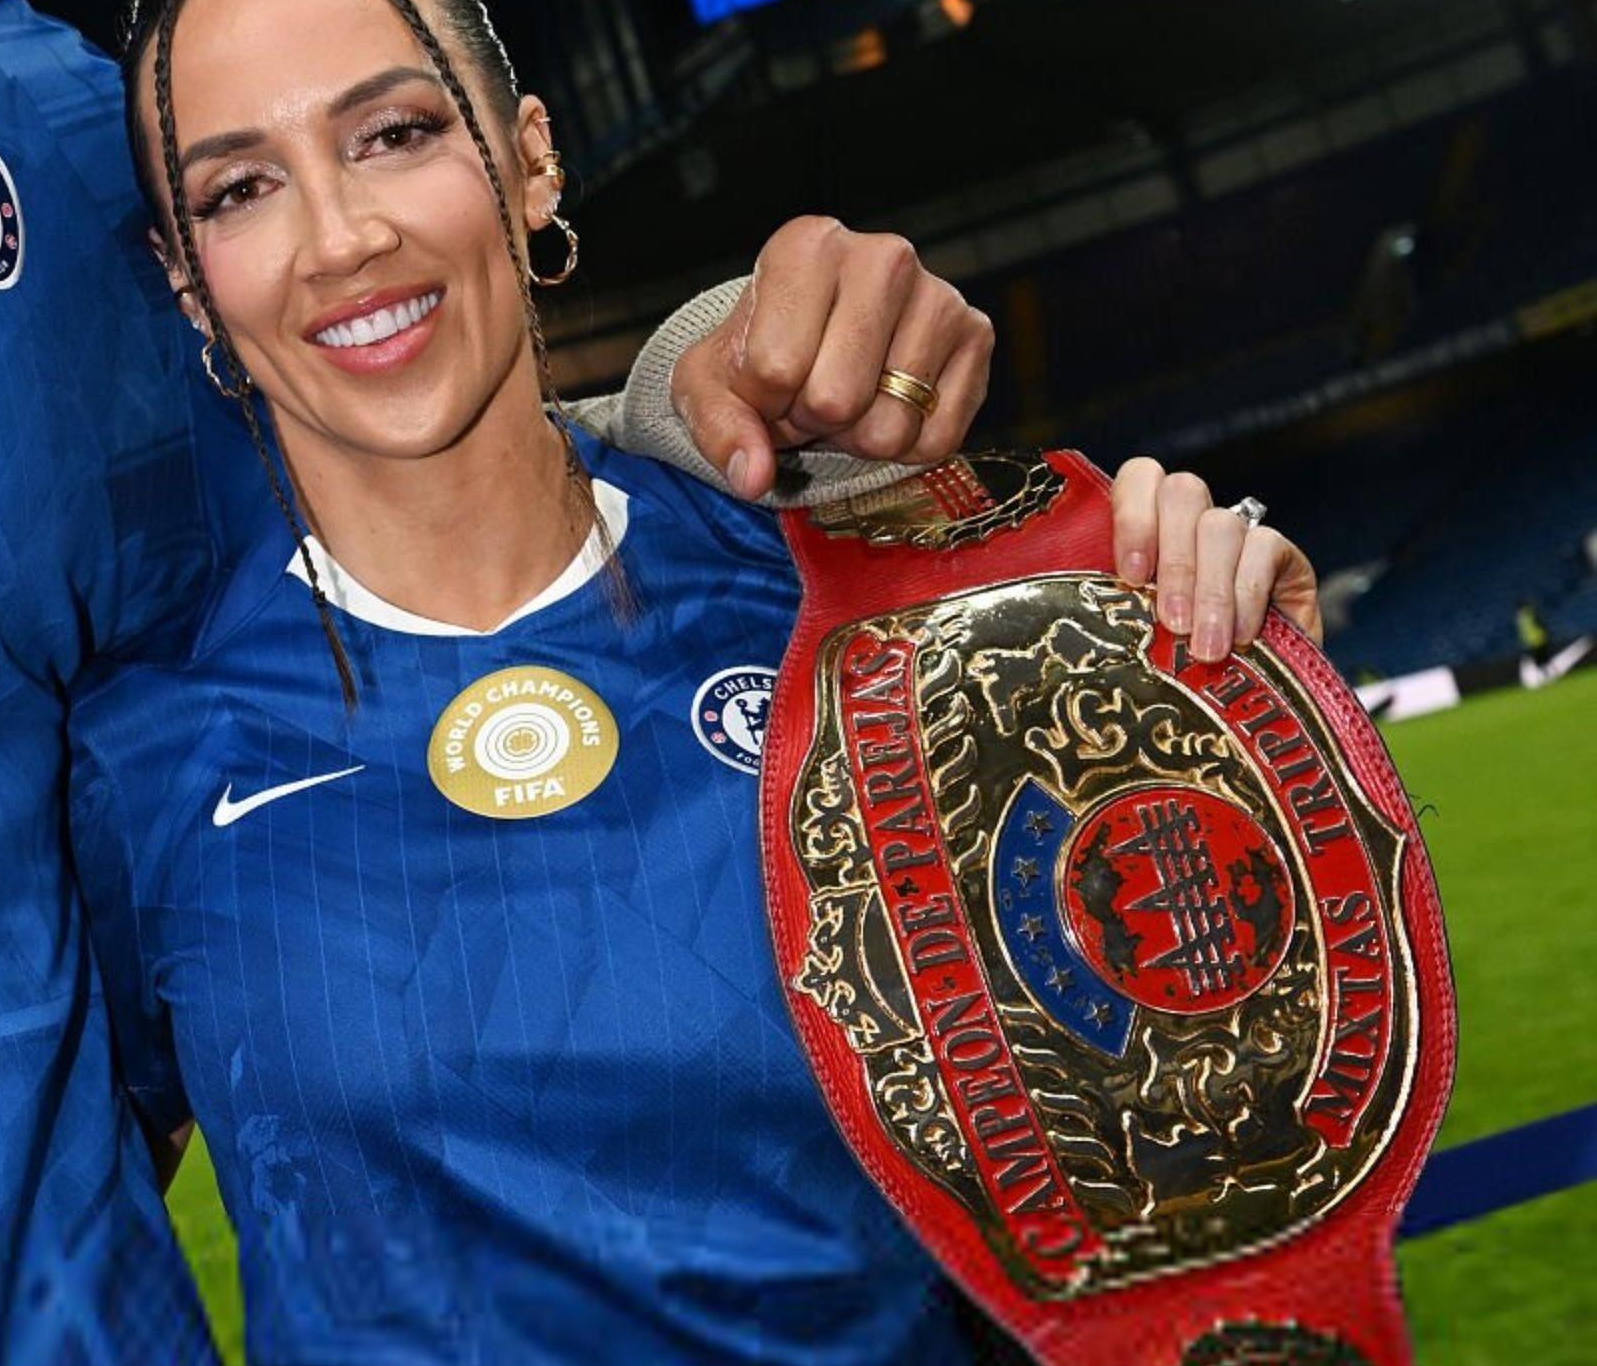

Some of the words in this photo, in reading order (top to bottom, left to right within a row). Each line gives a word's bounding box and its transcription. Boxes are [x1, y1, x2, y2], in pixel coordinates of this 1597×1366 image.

[444, 702, 484, 774] WORLD
[486, 680, 601, 747] CHAMPIONS
[714, 676, 773, 701] CHELS
[494, 778, 566, 808] FIFA
[850, 647, 941, 878] PAREJAS
[1202, 665, 1354, 856] TRIPLE
[900, 892, 967, 977] DE
[1303, 890, 1383, 1119] MIXTAS
[927, 989, 1086, 1257] CAMPEON
